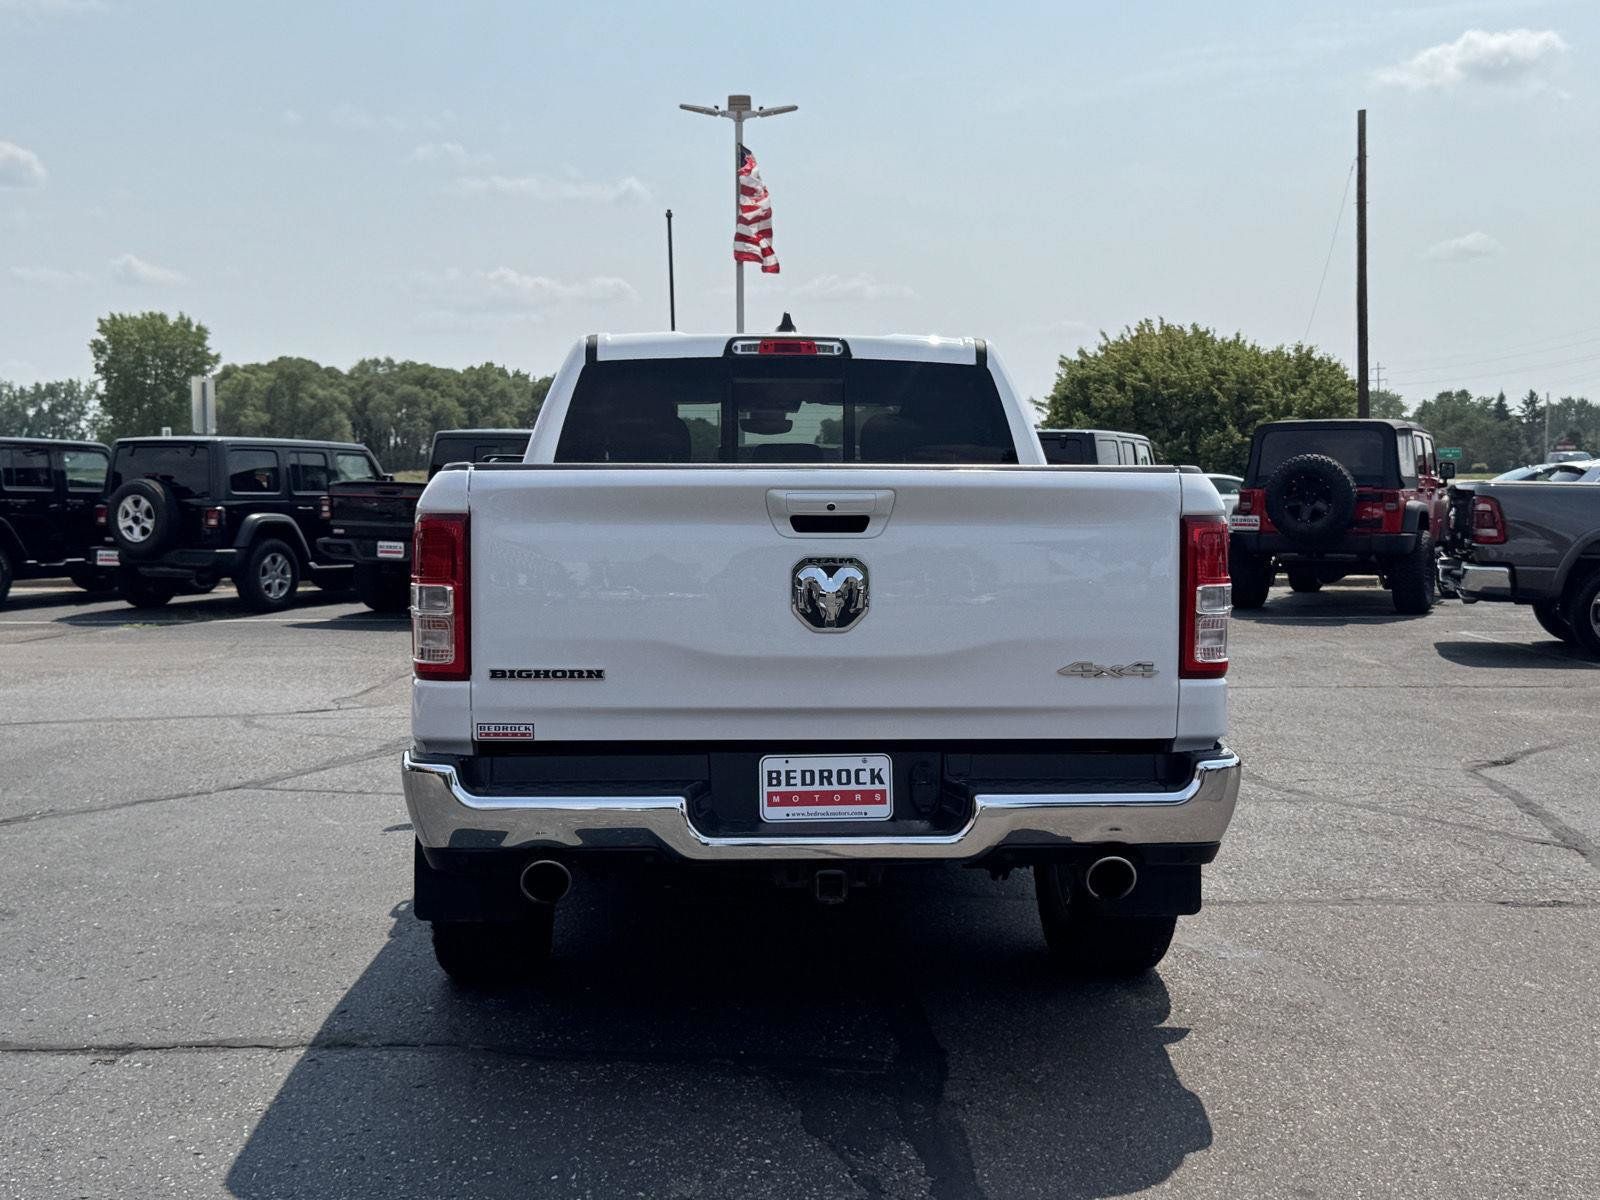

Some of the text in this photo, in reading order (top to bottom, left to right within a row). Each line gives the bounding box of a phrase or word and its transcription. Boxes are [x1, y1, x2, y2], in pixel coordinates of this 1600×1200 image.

[489, 669, 605, 680] BIGHORN
[766, 768, 885, 787] BEDROCK
[772, 794, 881, 803] MOTORS
[791, 810, 864, 818] www.bedrockmotors.com
